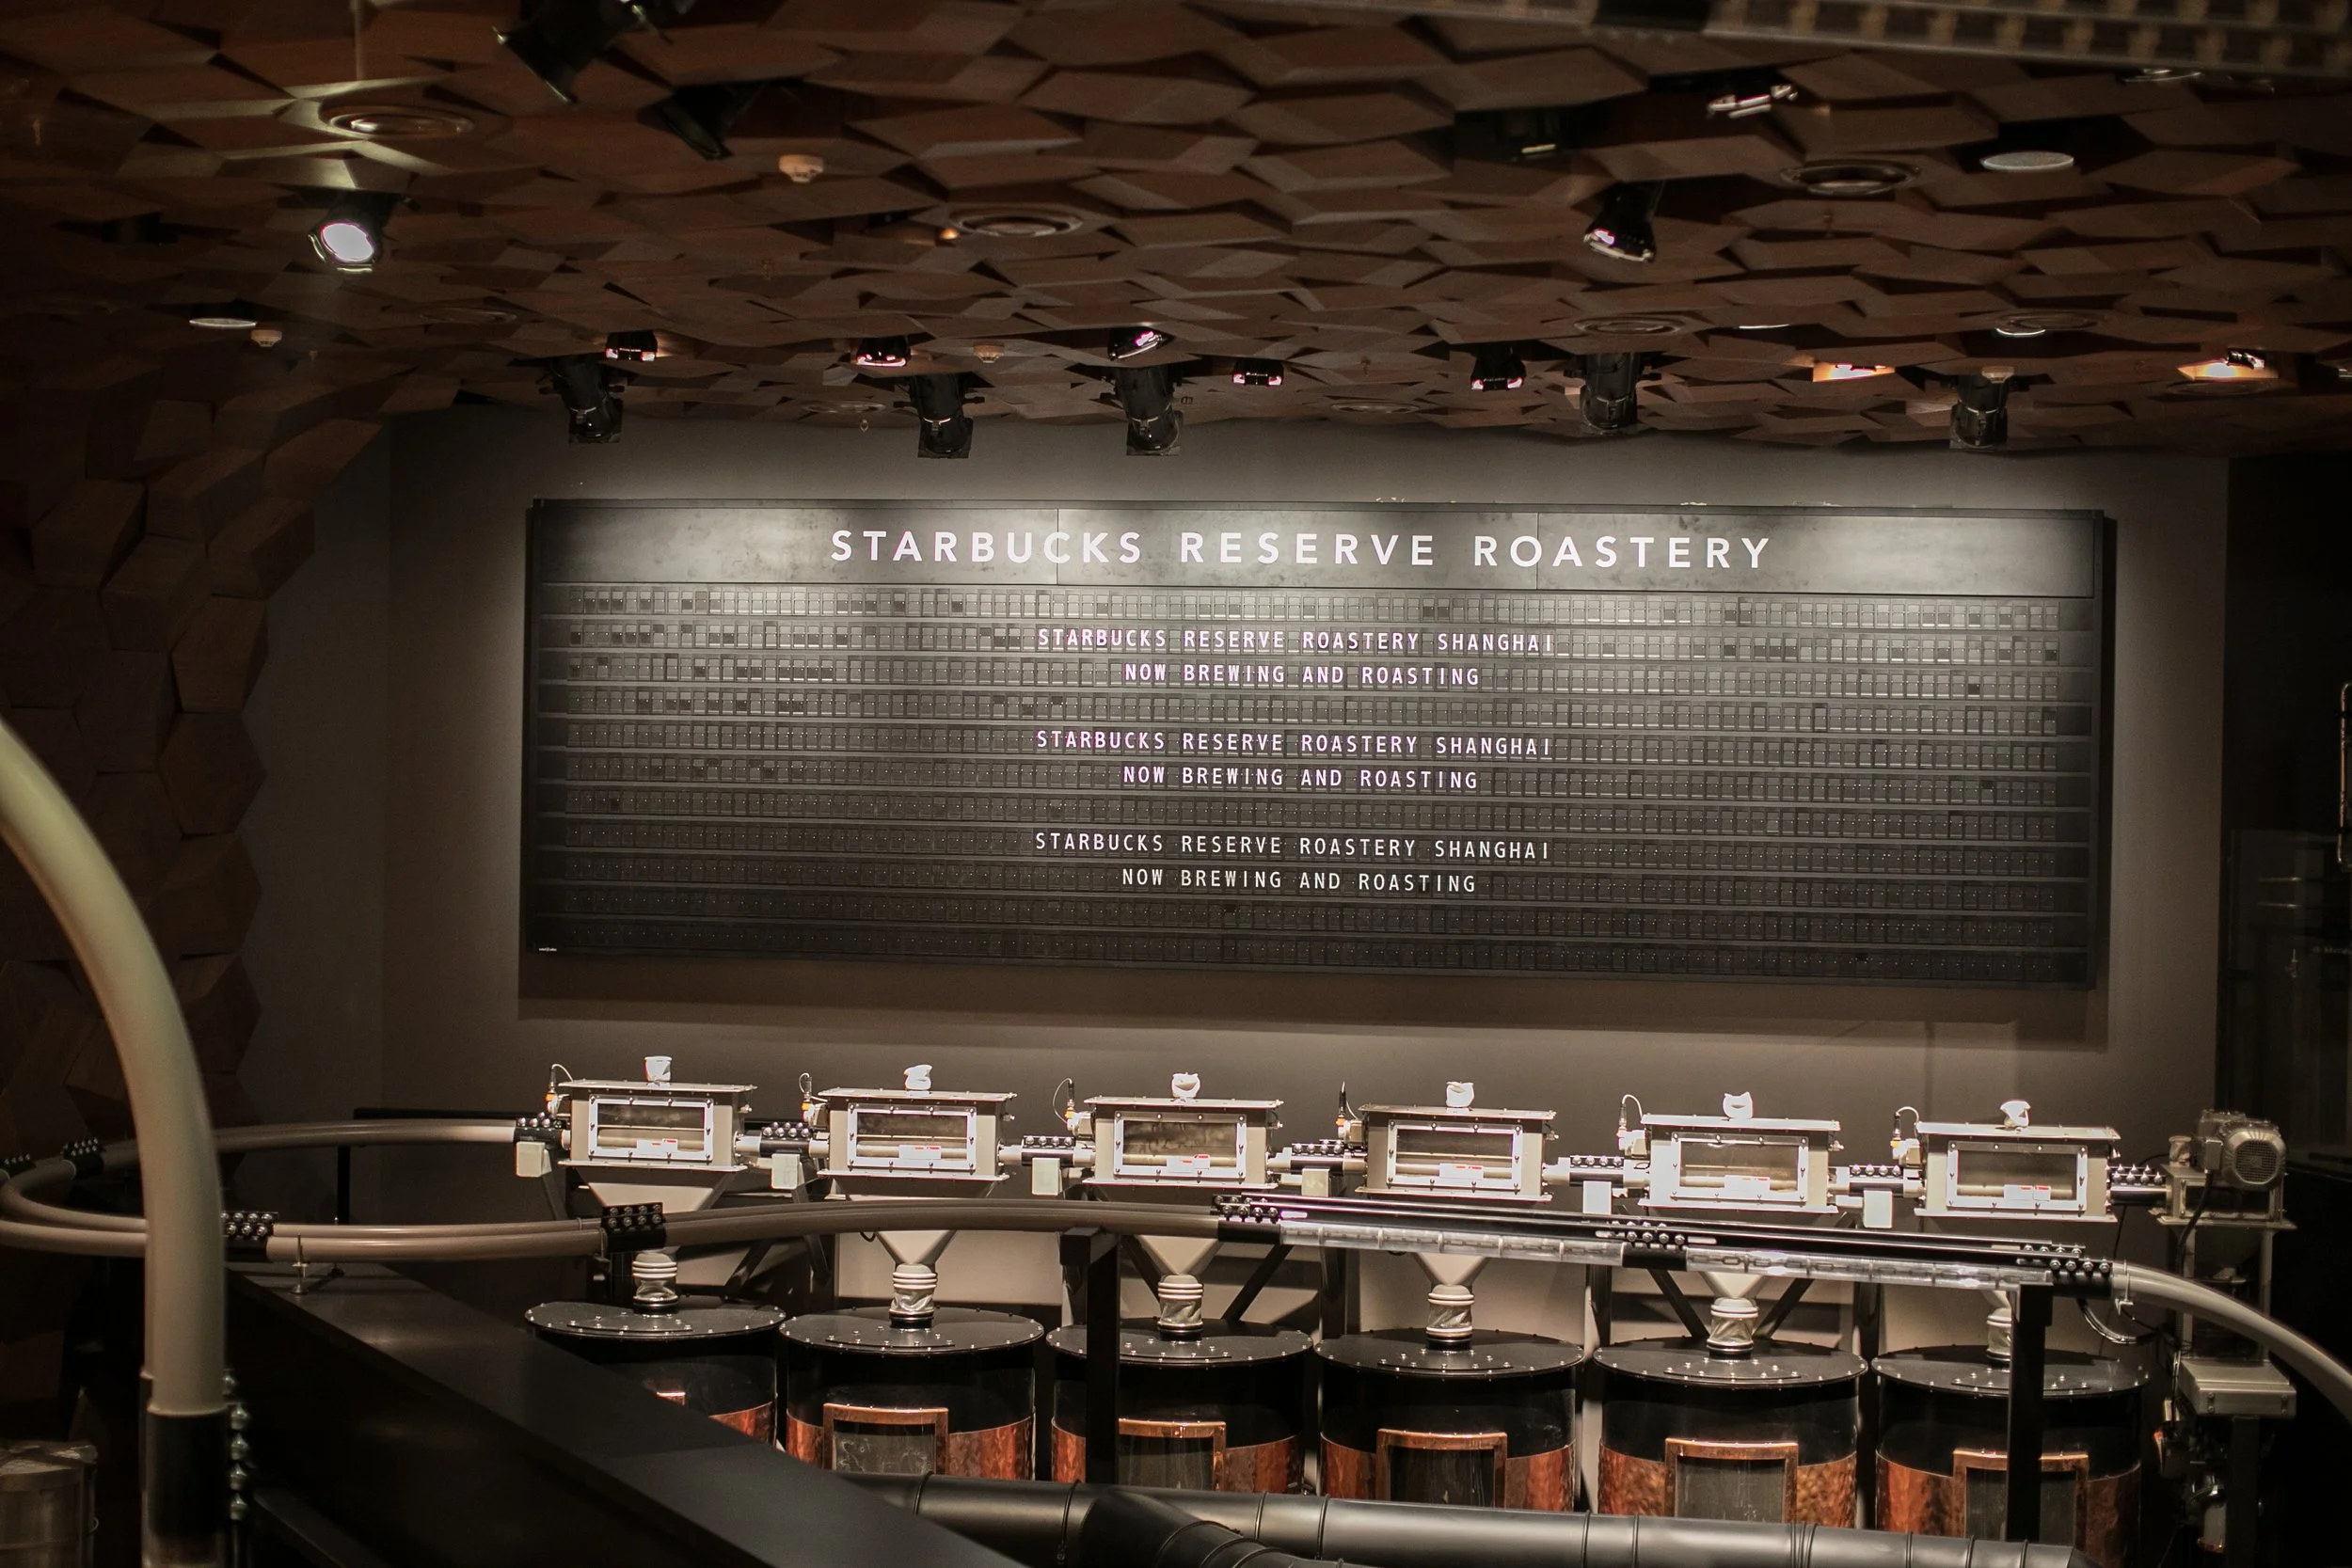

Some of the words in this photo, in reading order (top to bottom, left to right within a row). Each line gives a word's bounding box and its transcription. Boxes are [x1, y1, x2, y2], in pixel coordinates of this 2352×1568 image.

[831, 530, 1140, 564] STARBUCKS
[1181, 531, 1433, 565] RESERVE
[1474, 535, 1769, 568] ROASTERY
[1039, 628, 1166, 647] STARBUCKS
[1184, 630, 1284, 648] RESERVE
[1303, 631, 1419, 650] ROASTERY
[1438, 633, 1550, 652] SHANGHAI
[1125, 663, 1166, 681] NOW
[1184, 664, 1284, 683] BREWING
[1302, 666, 1343, 683] AND
[1361, 666, 1478, 686] ROASTING
[1037, 730, 1164, 750] STARBUCKS
[1183, 733, 1282, 751] RESERVE
[1301, 735, 1417, 753] ROASTERY
[1437, 736, 1549, 755] SHANGHAI
[1123, 766, 1165, 784] NOW
[1183, 767, 1282, 785] BREWING
[1300, 768, 1342, 786] AND
[1360, 769, 1477, 789] ROASTING
[1036, 832, 1163, 851] STARBUCKS
[1182, 835, 1280, 853] RESERVE
[1300, 837, 1415, 857] ROASTERY
[1435, 840, 1548, 860] SHANGHAI
[1122, 868, 1163, 886] NOW
[1181, 869, 1281, 888] BREWING
[1299, 872, 1341, 889] AND
[1359, 873, 1474, 893] ROASTING
